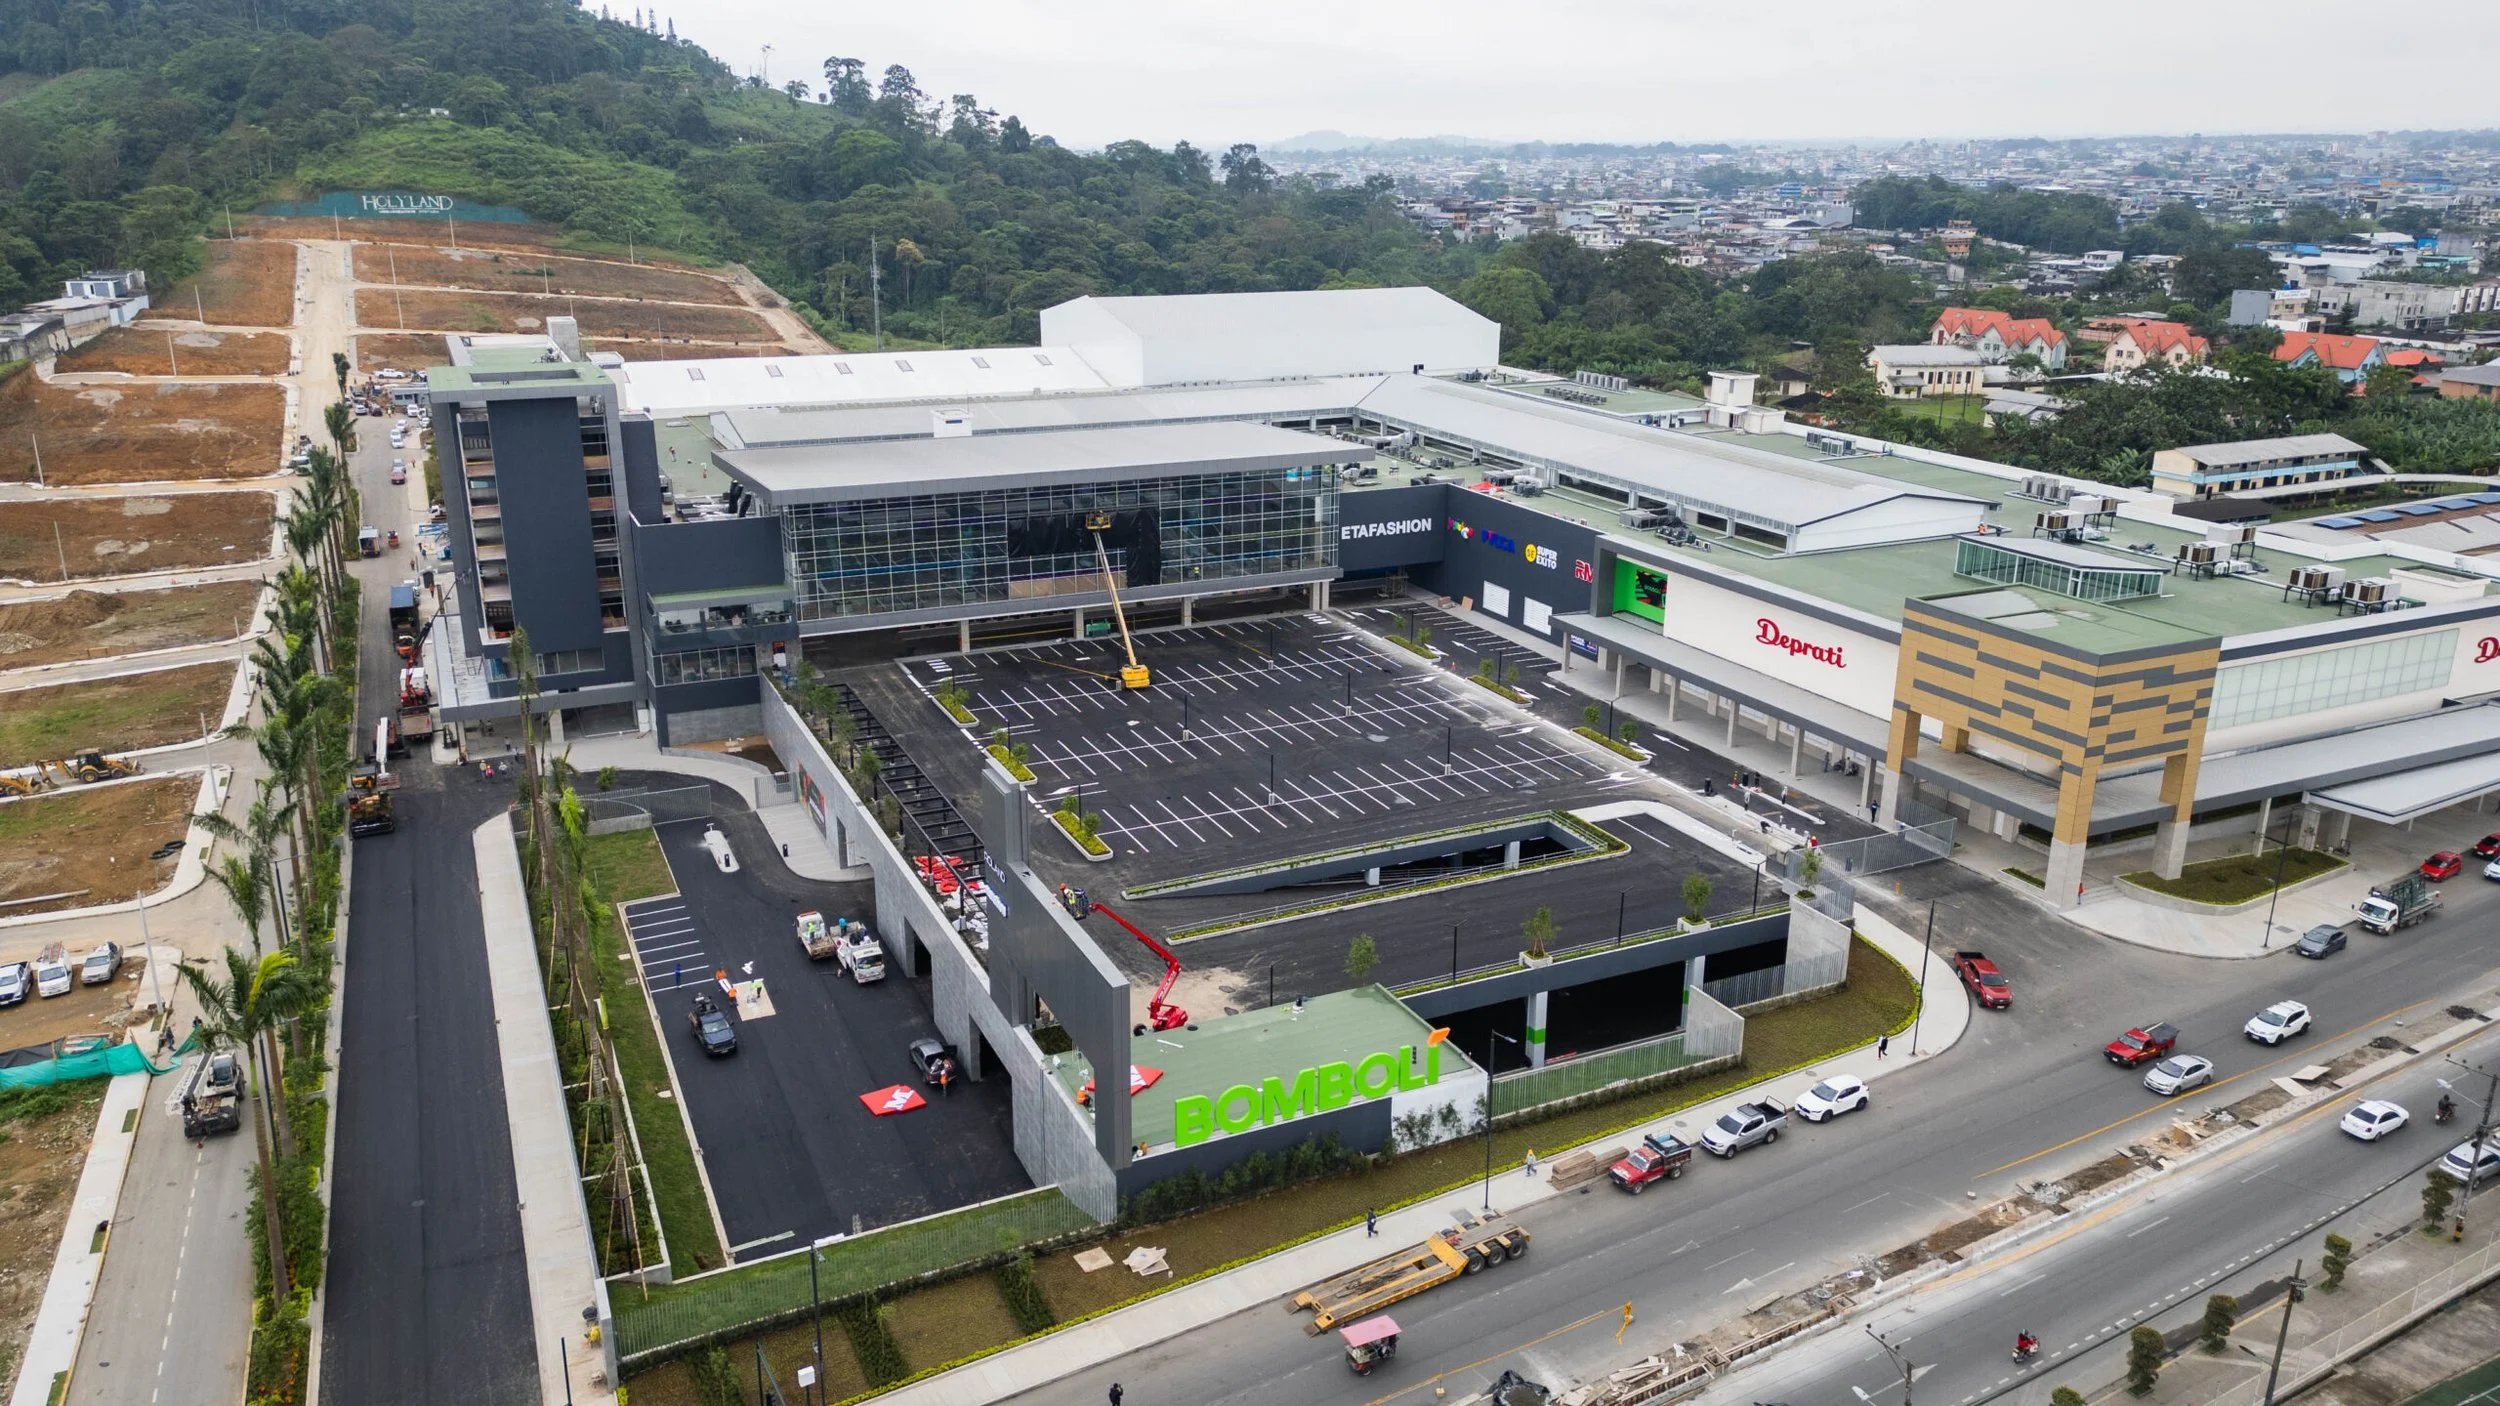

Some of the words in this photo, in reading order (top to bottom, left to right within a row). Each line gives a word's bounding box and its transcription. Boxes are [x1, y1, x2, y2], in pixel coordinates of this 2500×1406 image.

[1341, 518, 1432, 540] ETAFASHION
[1536, 545, 1558, 561] SUPER
[1755, 618, 1847, 668] Deprati
